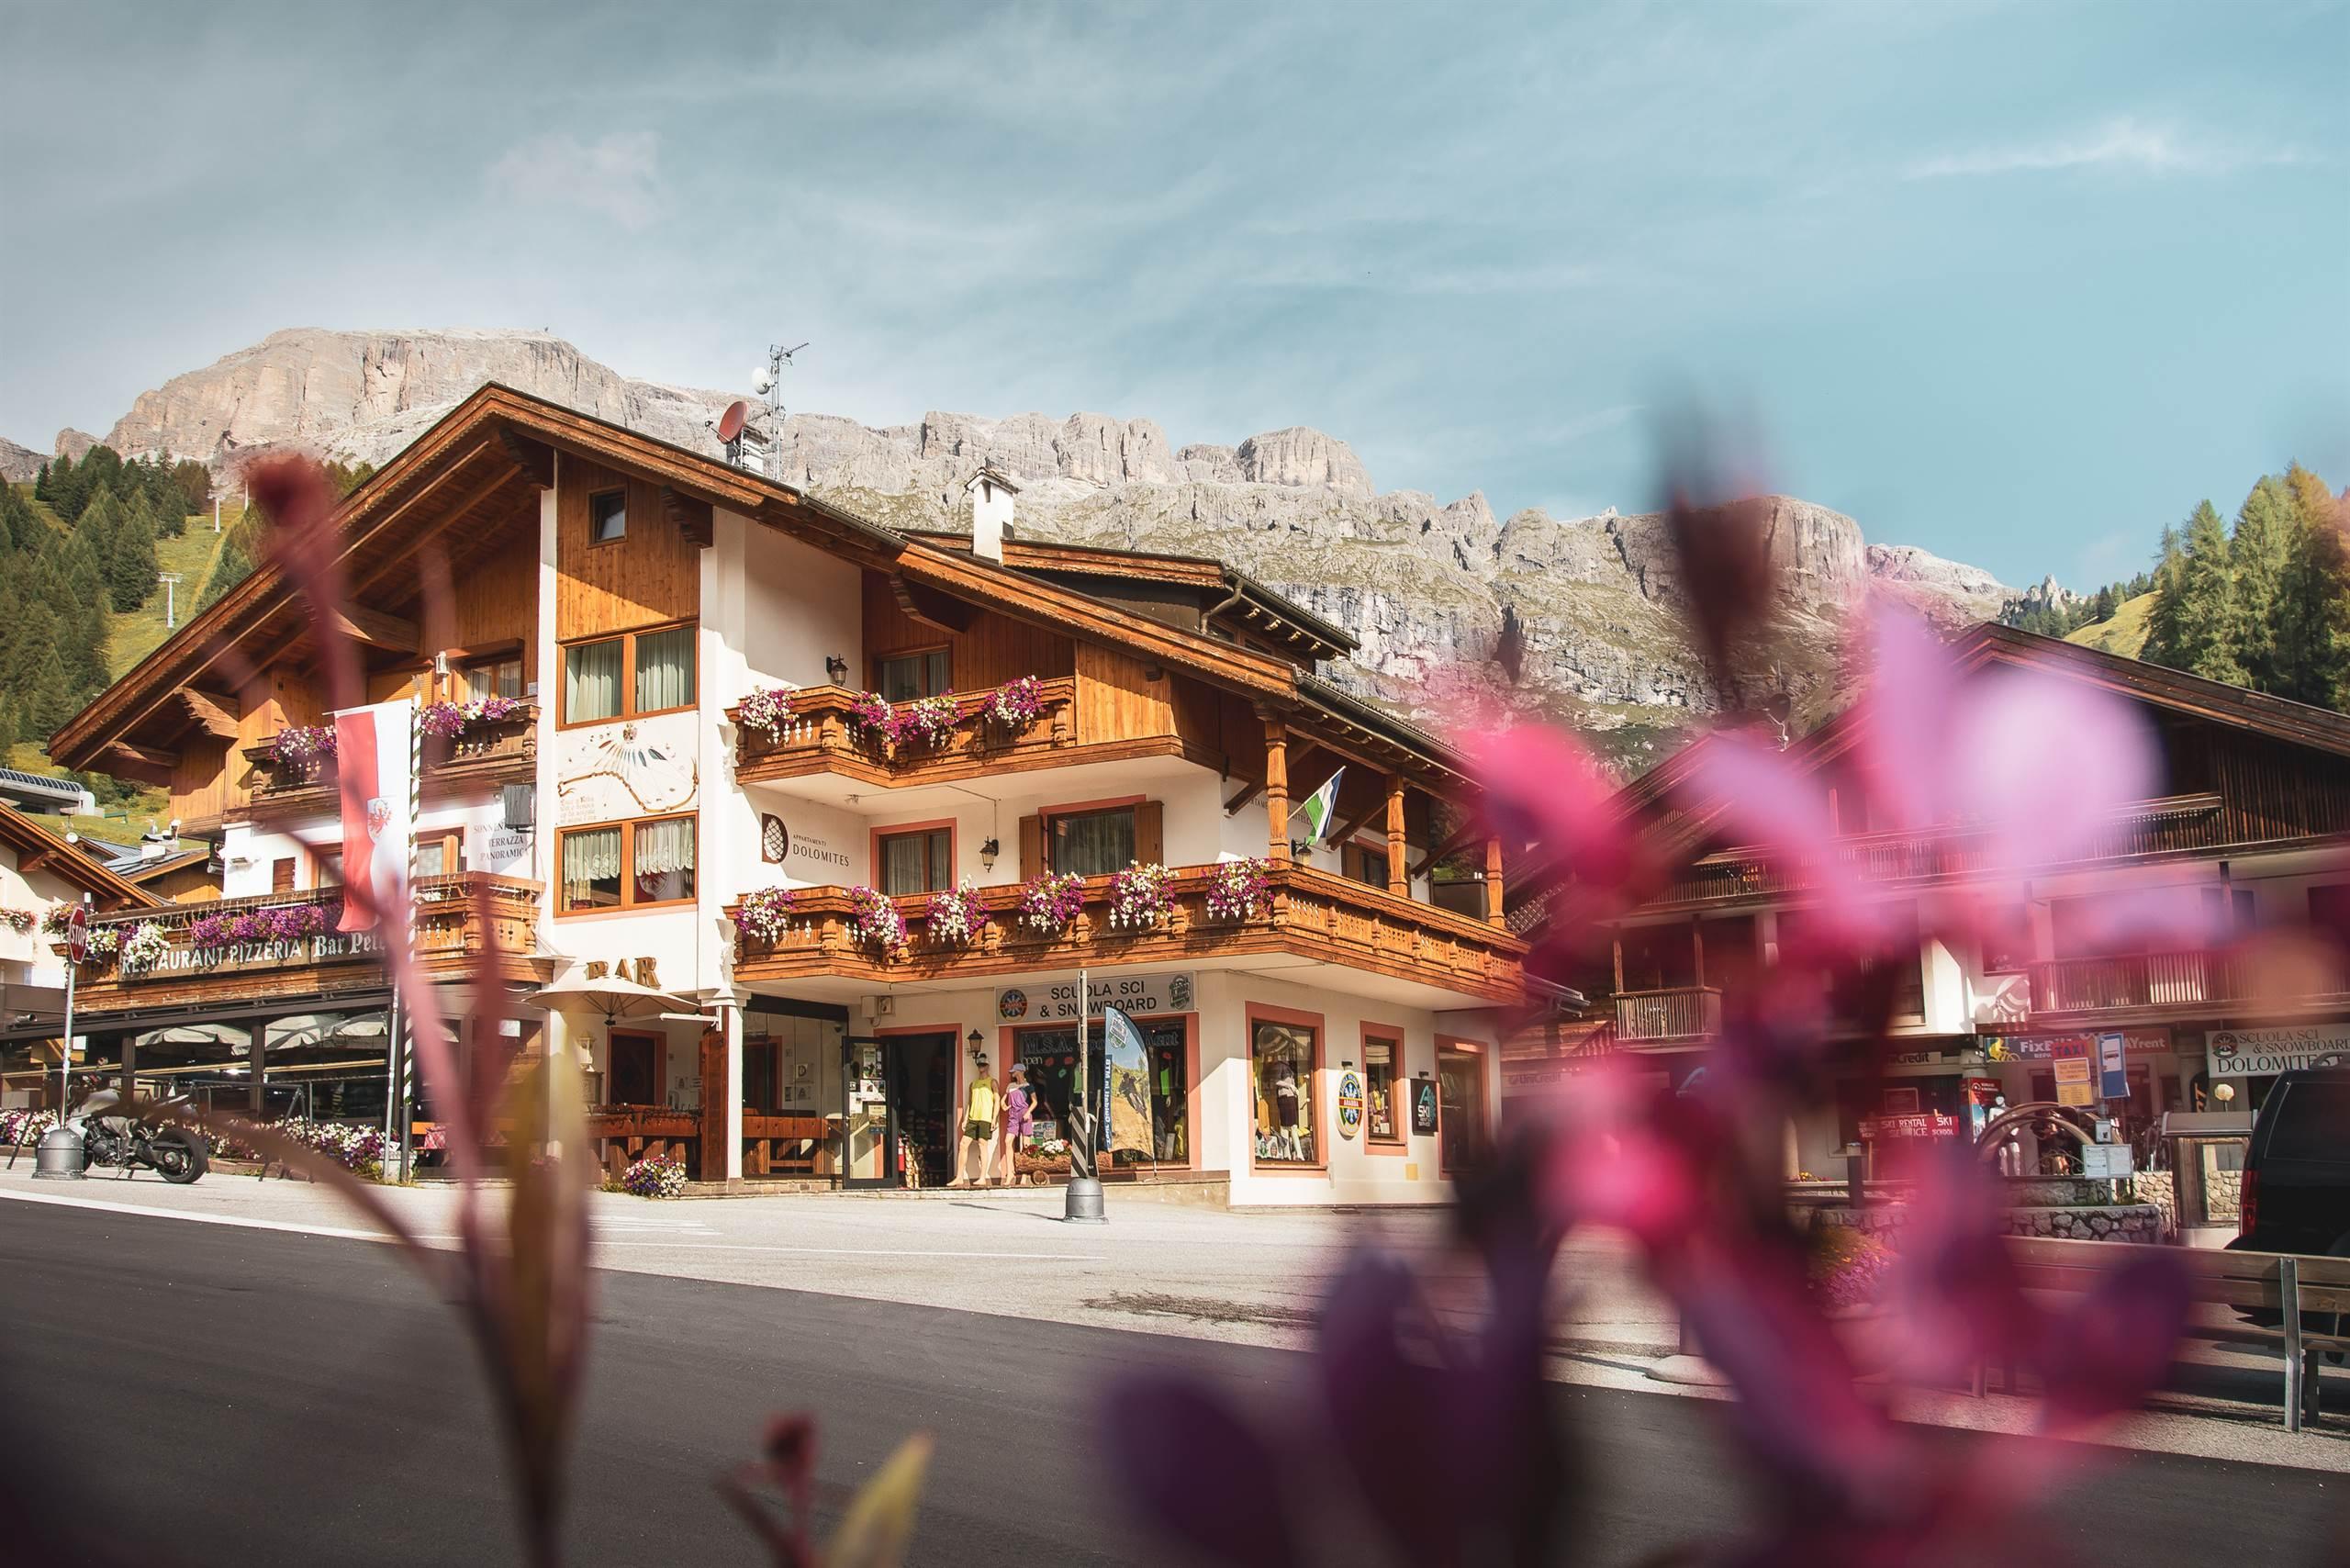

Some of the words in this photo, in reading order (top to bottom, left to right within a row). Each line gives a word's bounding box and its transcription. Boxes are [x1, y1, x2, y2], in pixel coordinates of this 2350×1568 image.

[792, 845, 849, 867] DOLOMITES
[71, 924, 86, 946] STOP
[229, 940, 301, 964] PIZZERIA
[313, 935, 344, 958] Bar
[587, 957, 661, 988] BAR
[1120, 980, 1145, 995] SCI
[1039, 1006, 1050, 1017] &
[2239, 1030, 2293, 1044] SCUOLA
[2297, 1029, 2319, 1041] SCI
[2055, 1043, 2087, 1057] TAXI
[2253, 1043, 2262, 1055] &
[1417, 1104, 1430, 1117] SKI
[1882, 1121, 1895, 1129] SKI
[1899, 1118, 1927, 1127] RENTAL
[1937, 1115, 1953, 1126] SKI
